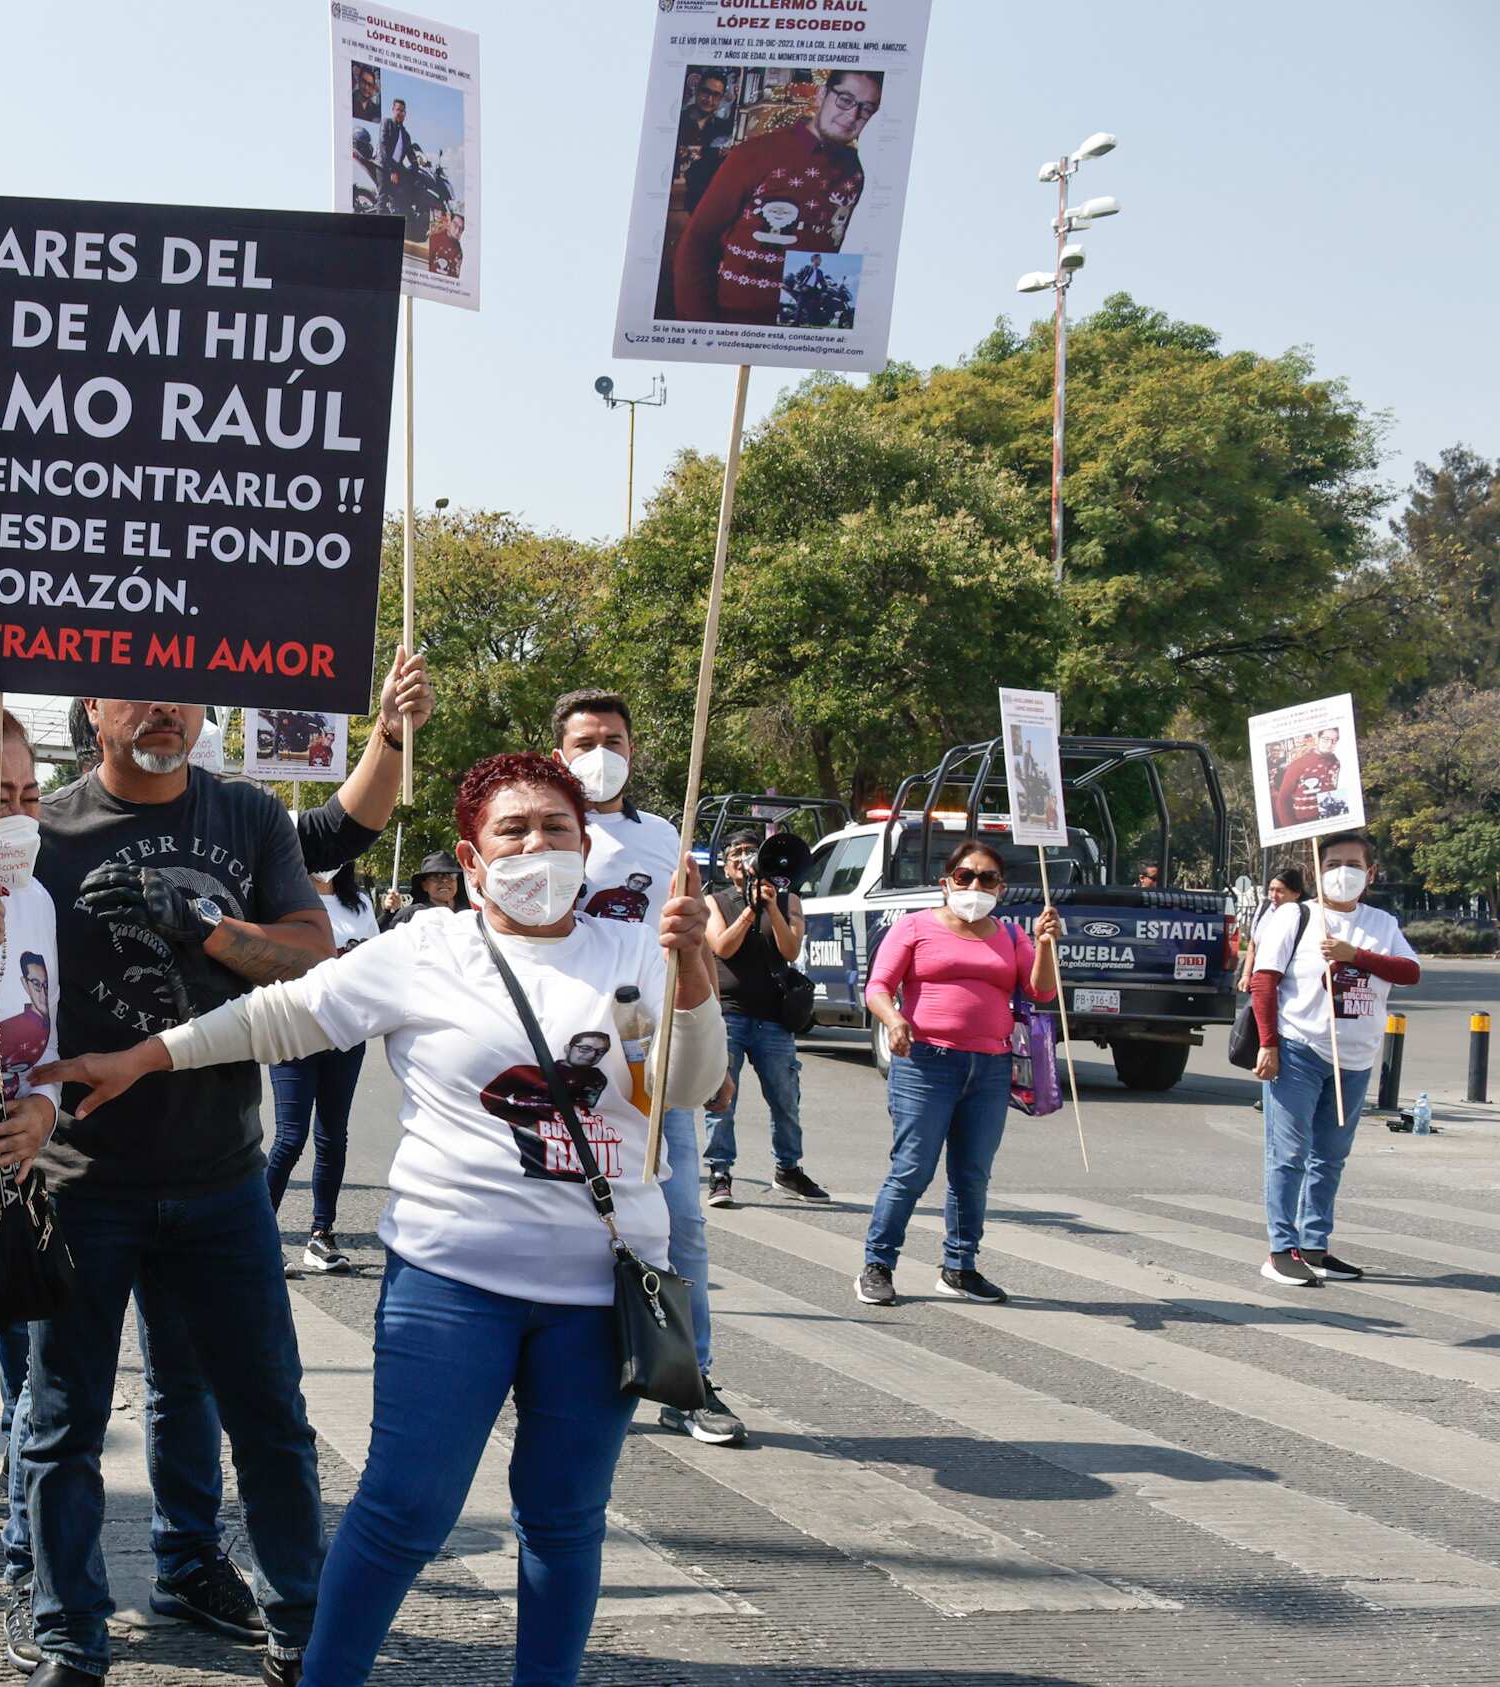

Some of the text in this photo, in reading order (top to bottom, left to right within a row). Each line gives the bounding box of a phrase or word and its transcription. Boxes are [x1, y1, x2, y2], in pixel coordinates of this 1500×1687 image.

[716, 14, 865, 31] LÓPEZ ESCOBEDO
[162, 237, 272, 289] DEL
[12, 301, 88, 350] DE
[108, 305, 180, 355] MI
[205, 311, 345, 365] HIJO
[162, 370, 360, 451] RAÚL
[338, 478, 364, 513] !!
[123, 521, 170, 557] EL
[187, 525, 350, 568] FONDO
[146, 635, 195, 668] MI
[208, 639, 334, 677] AMOR
[192, 836, 254, 900] LUCK
[1088, 924, 1116, 936] Ford
[1136, 920, 1217, 941] ESTATAL
[810, 940, 844, 966] ESTATAL
[1058, 945, 1135, 962] PUEBLA
[89, 980, 178, 1032] NEXT
